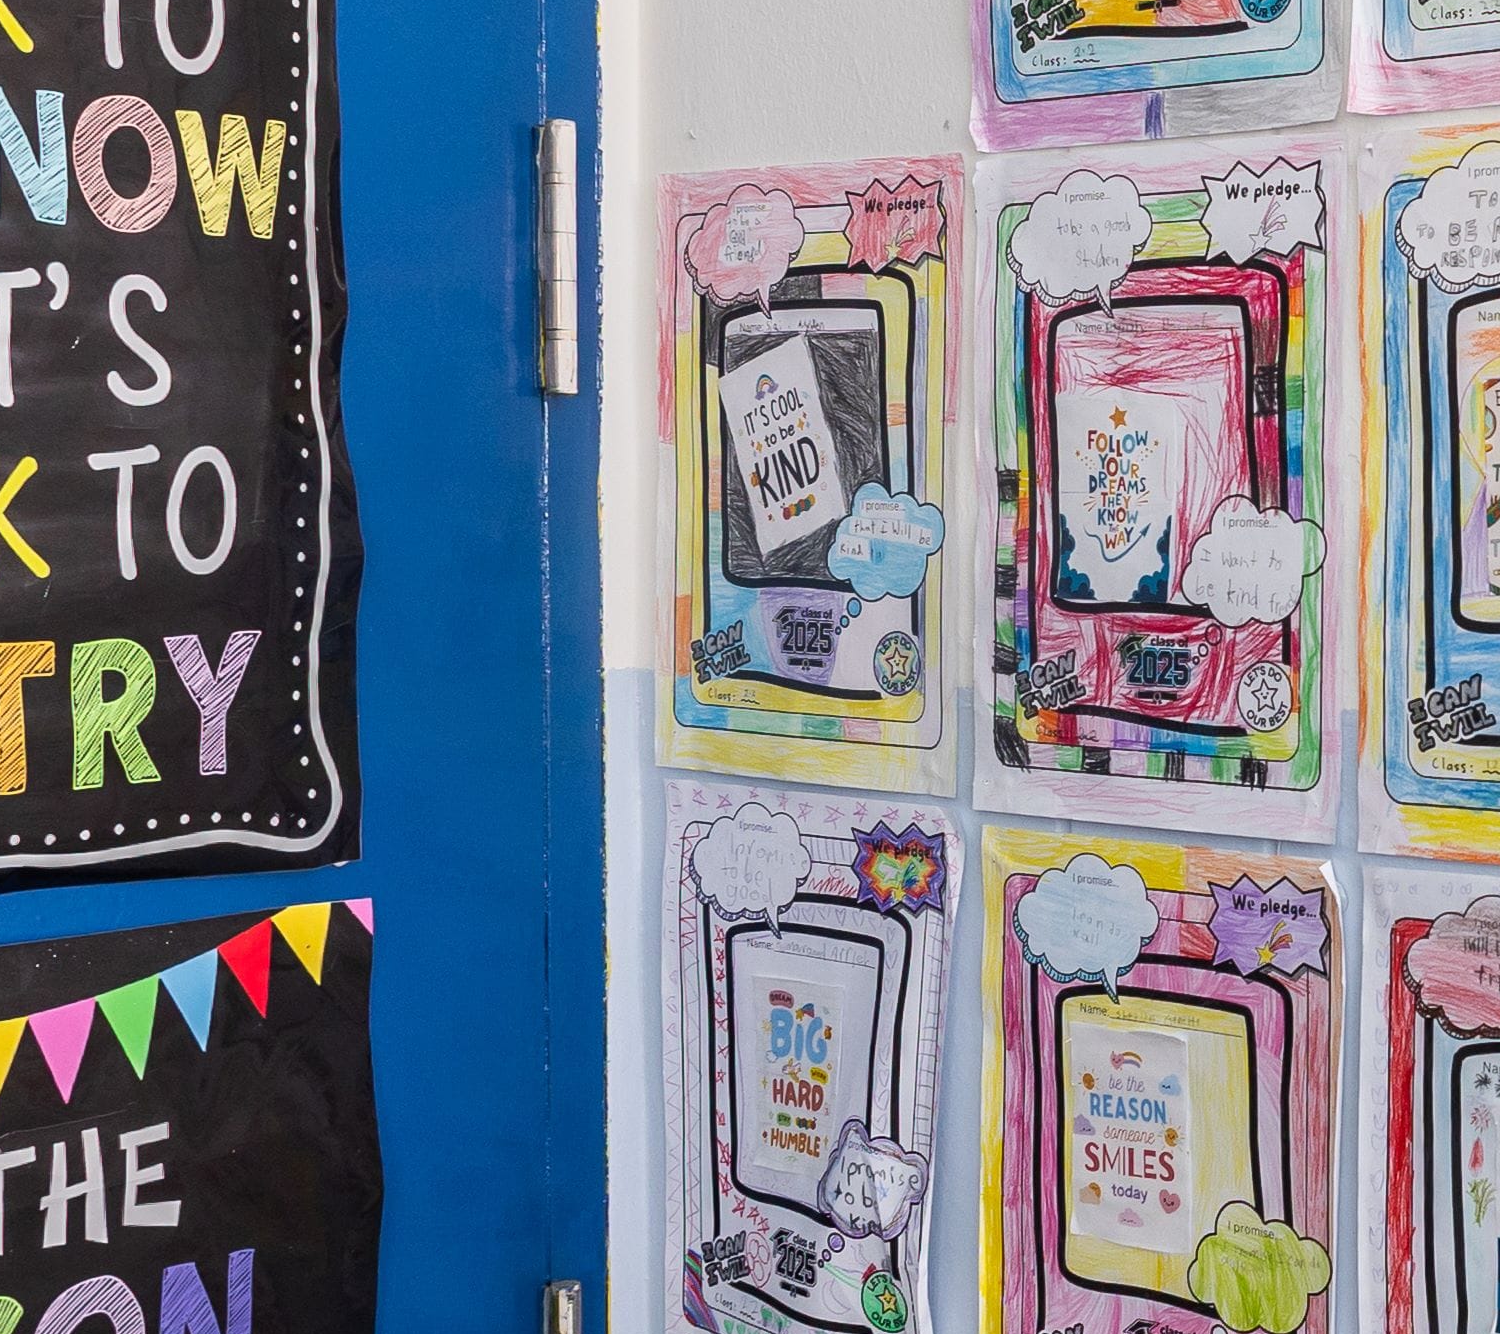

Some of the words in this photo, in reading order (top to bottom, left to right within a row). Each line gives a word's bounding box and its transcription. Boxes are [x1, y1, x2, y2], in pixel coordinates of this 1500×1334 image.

[1225, 184, 1249, 200] We
[1254, 182, 1311, 203] pledge...
[744, 406, 772, 437] IT'S
[771, 387, 804, 421] COOL
[1088, 429, 1148, 457] FOLLOW
[754, 435, 820, 508] KIND
[1099, 454, 1139, 478] YOUR
[1089, 475, 1146, 495] DREAMS
[87, 443, 239, 583] TO
[1101, 492, 1130, 510] THEY
[1097, 508, 1138, 525] KNOW
[1105, 528, 1133, 550] WAY
[772, 1078, 824, 1111] HARD
[1108, 1073, 1123, 1091] be
[1126, 1075, 1145, 1093] the
[1089, 1092, 1167, 1124] REASON
[770, 1128, 820, 1158] HUMBLE
[1102, 1125, 1156, 1145] someone
[1084, 1142, 1175, 1182] SMILES
[1111, 1182, 1148, 1202] today
